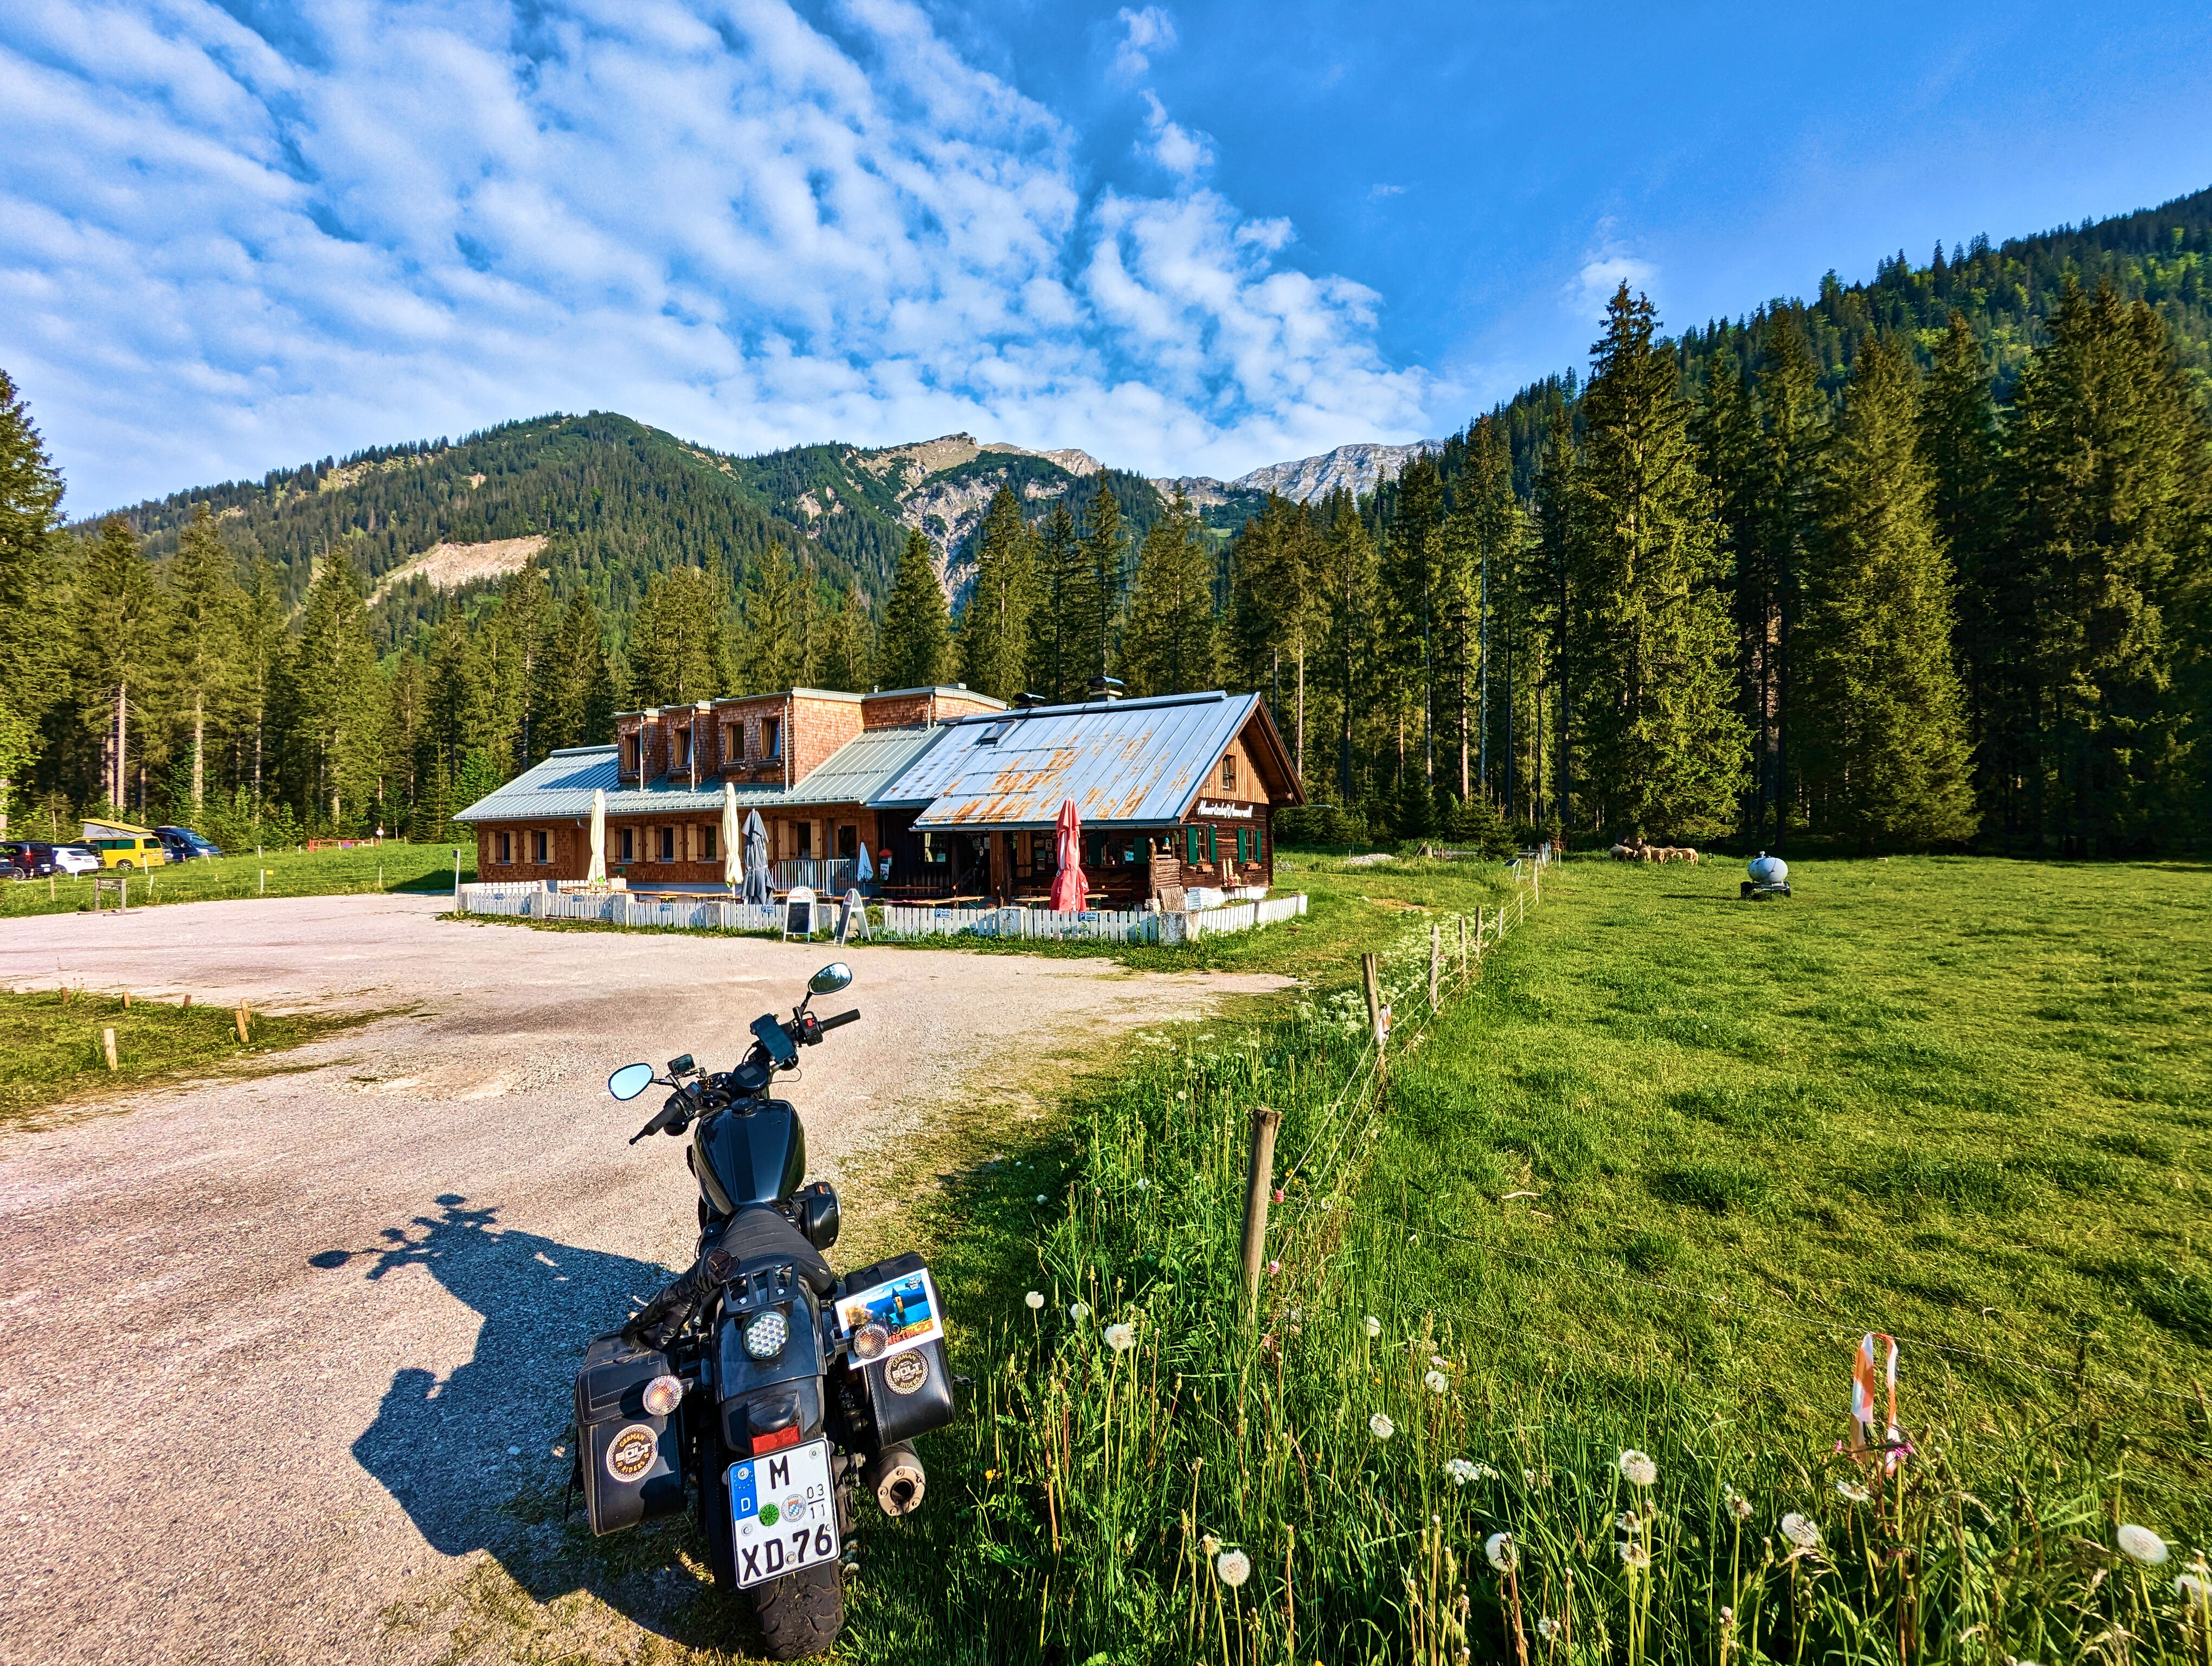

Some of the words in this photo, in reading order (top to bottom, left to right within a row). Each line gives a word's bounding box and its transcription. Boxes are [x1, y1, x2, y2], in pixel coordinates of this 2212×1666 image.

[892, 1354, 917, 1367] GERMAN
[892, 1362, 921, 1379] BOLT
[900, 1376, 920, 1388] RIDERS
[619, 1433, 646, 1447] GERMAN
[615, 1443, 651, 1462] BOLT
[621, 1460, 645, 1473] RIDERS
[769, 1455, 790, 1490] M
[807, 1484, 824, 1499] 03
[741, 1497, 750, 1512] D
[810, 1504, 826, 1519] 11
[742, 1538, 785, 1581] XD
[793, 1523, 832, 1564] 76
